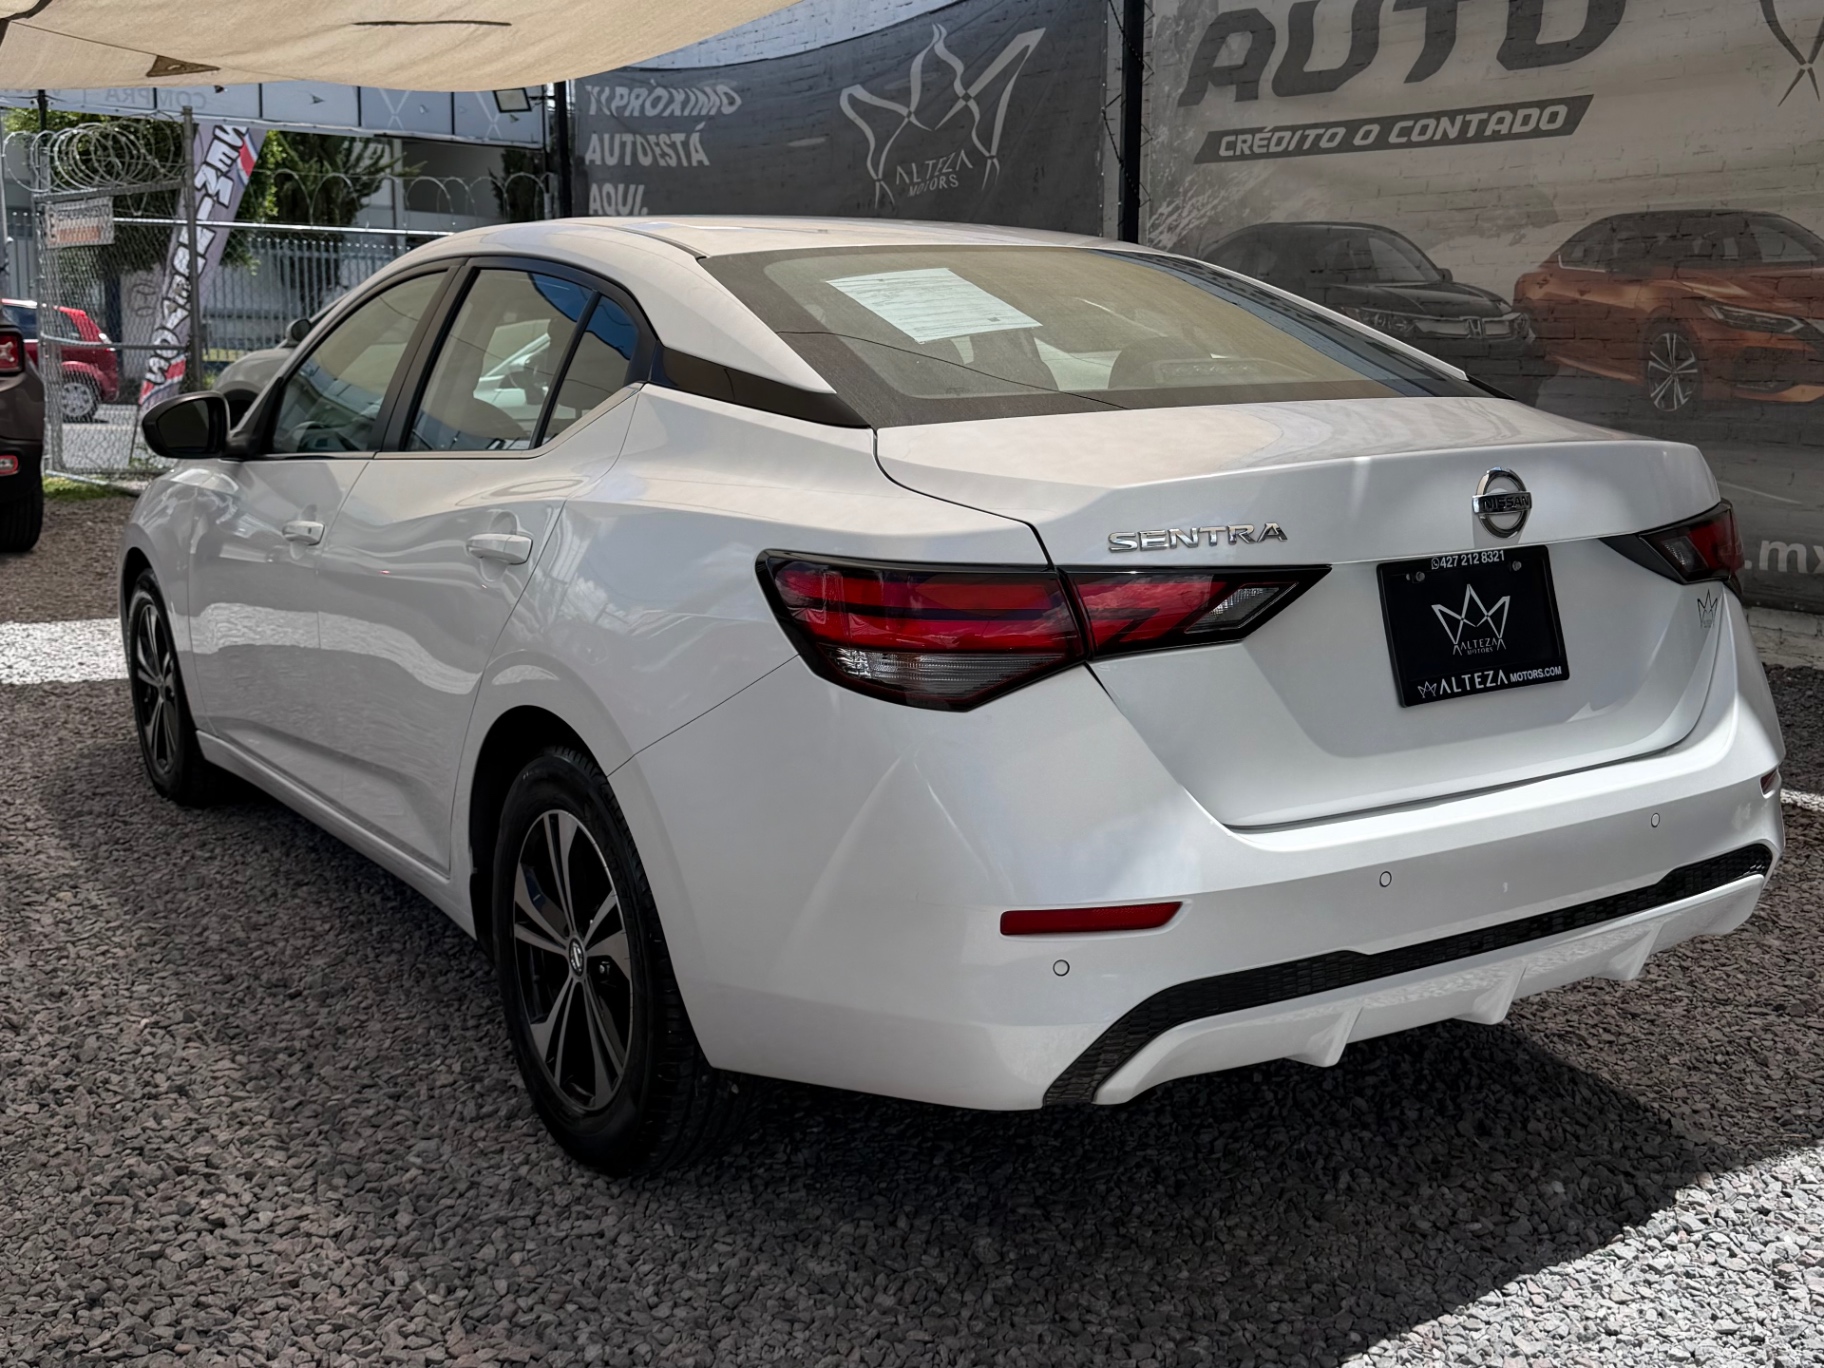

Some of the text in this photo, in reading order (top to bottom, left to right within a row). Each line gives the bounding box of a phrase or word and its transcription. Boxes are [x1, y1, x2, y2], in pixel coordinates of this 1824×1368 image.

[1218, 104, 1569, 157] CRÉDITO O CONTADO
[896, 149, 973, 185] ALTEZA
[908, 174, 959, 197] MOTORS
[1482, 496, 1529, 510] NISSAN
[1108, 522, 1288, 553] SENTRA
[1440, 550, 1505, 569] 427 212 8321
[1460, 637, 1498, 650] ALTEZA
[1467, 647, 1493, 655] MOTORS
[1439, 666, 1562, 695] ALTEZA MOTORS.COM
